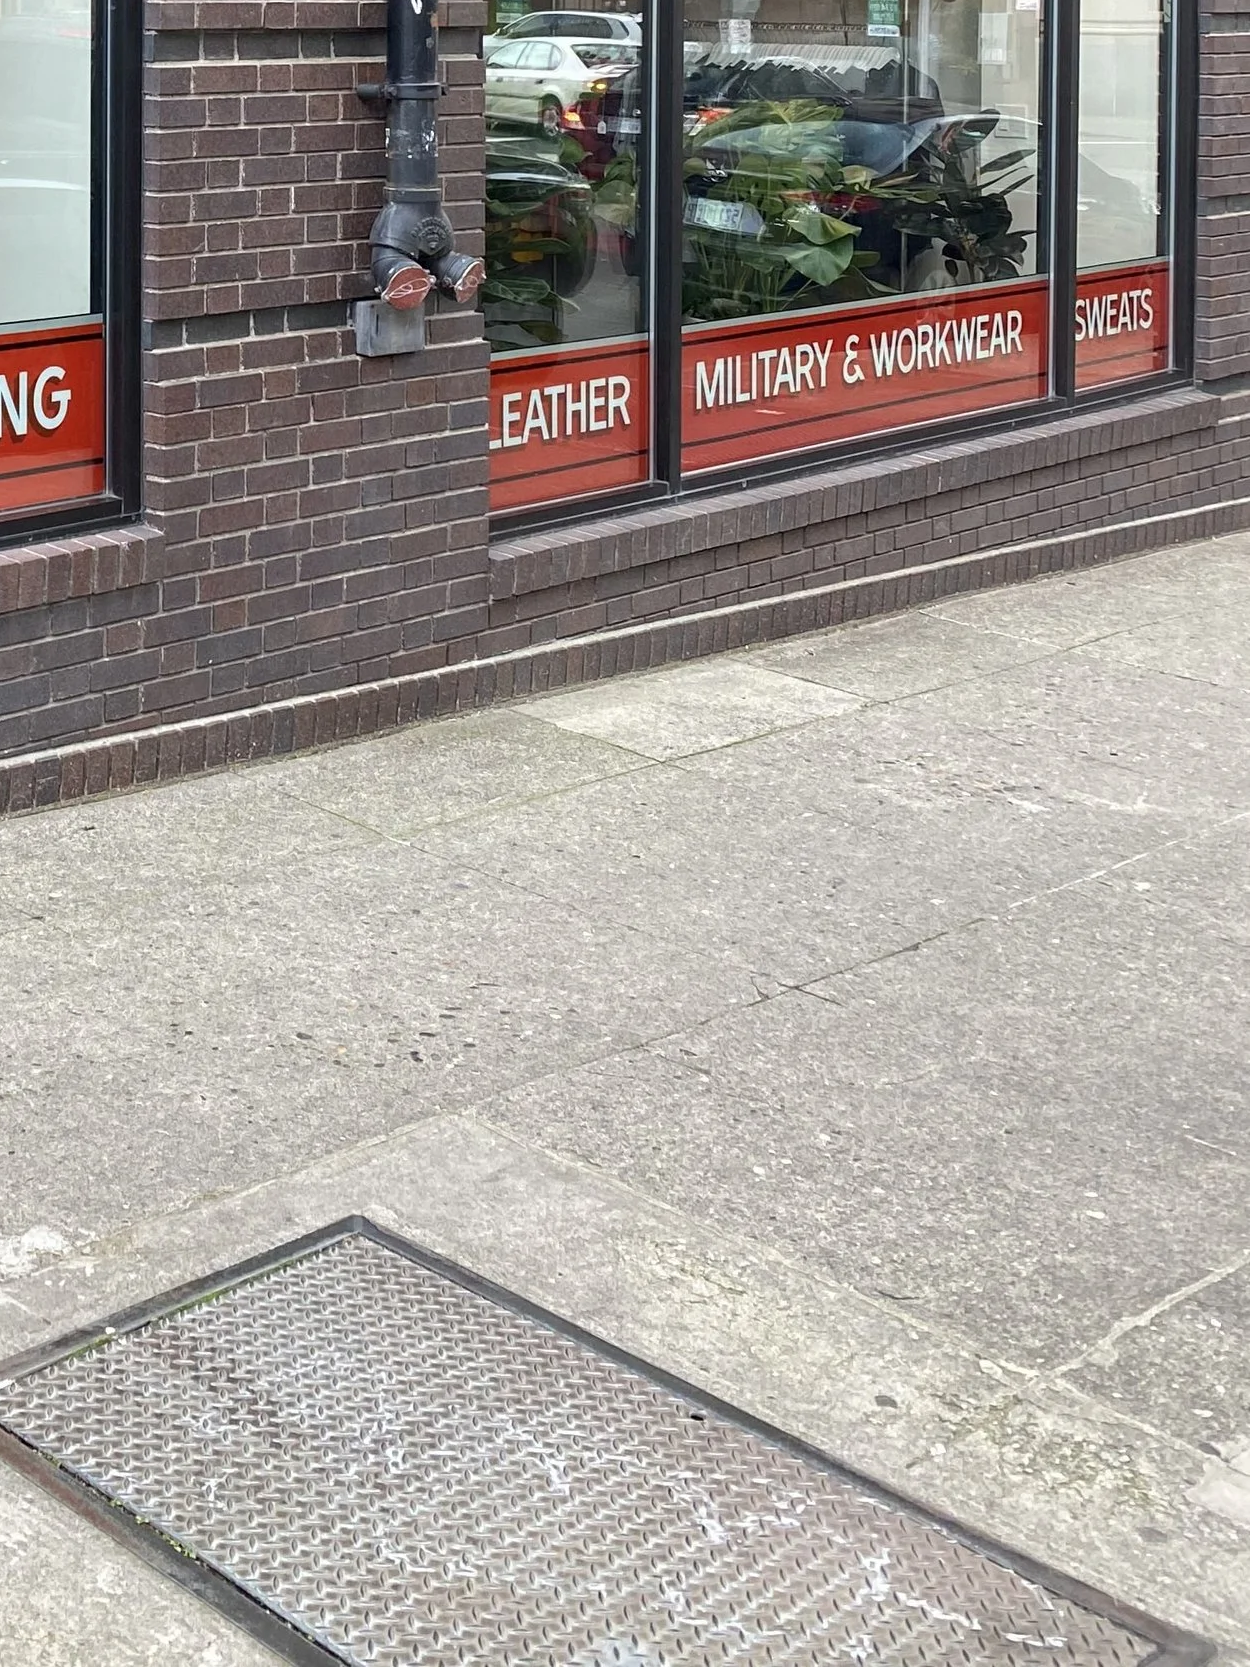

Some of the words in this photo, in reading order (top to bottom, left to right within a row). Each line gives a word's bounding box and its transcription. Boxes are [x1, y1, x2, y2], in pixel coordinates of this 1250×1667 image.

[1075, 288, 1154, 341] SWEATS
[696, 339, 834, 409] MILITARY
[843, 334, 865, 384] &
[870, 309, 1023, 378] WORKWEAR
[488, 375, 631, 450] EATHER
